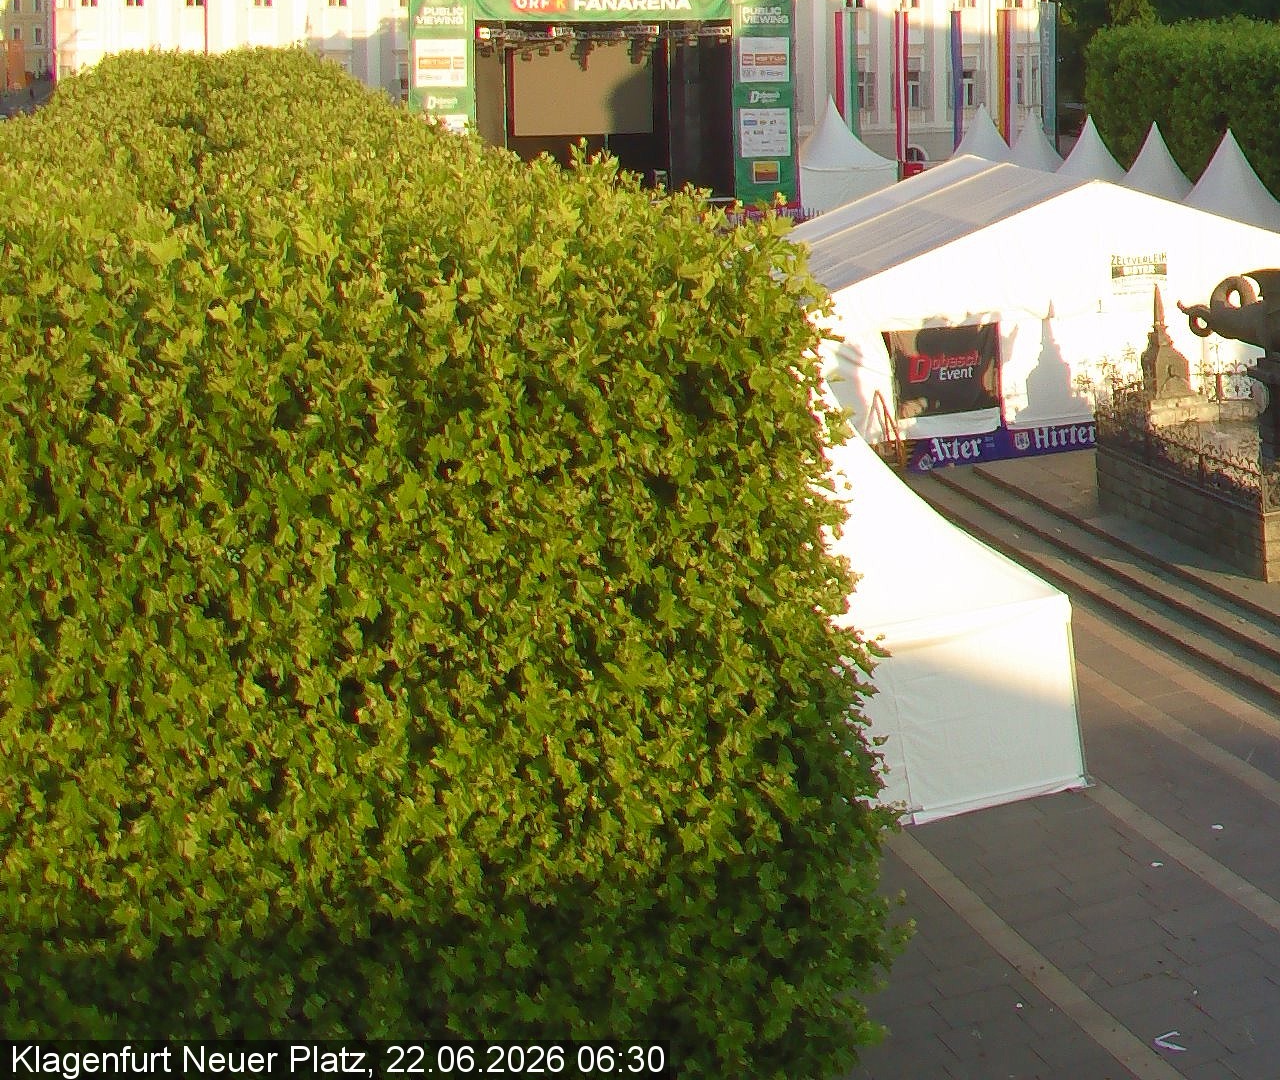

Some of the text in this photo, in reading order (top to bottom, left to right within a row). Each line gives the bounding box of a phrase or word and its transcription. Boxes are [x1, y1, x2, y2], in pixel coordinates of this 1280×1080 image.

[423, 6, 464, 16] PUBLIC
[742, 6, 782, 15] PUBLIC
[416, 15, 464, 25] VIEWING
[743, 14, 789, 24] VIEWING
[940, 366, 974, 381] Event
[1034, 424, 1097, 449] Hirter
